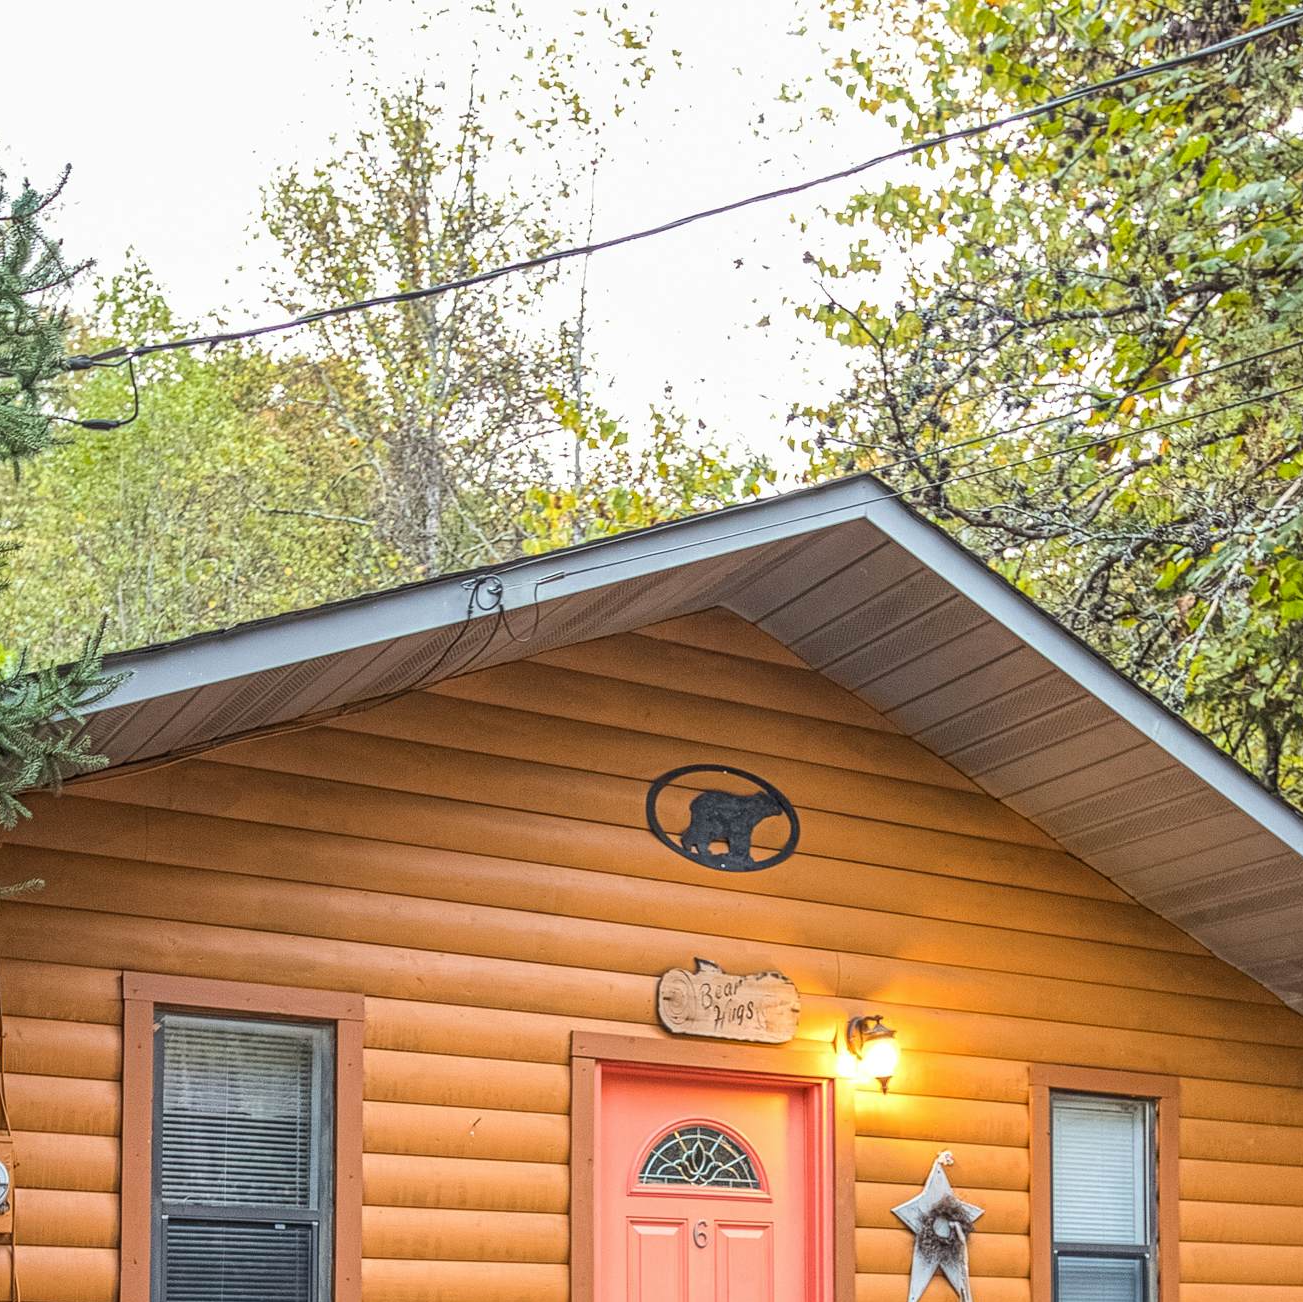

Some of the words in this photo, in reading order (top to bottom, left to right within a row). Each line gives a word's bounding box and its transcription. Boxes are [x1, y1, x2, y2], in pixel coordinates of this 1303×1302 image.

[700, 980, 743, 1010] Bear
[714, 1000, 754, 1031] Hugs
[692, 1220, 708, 1249] 6
